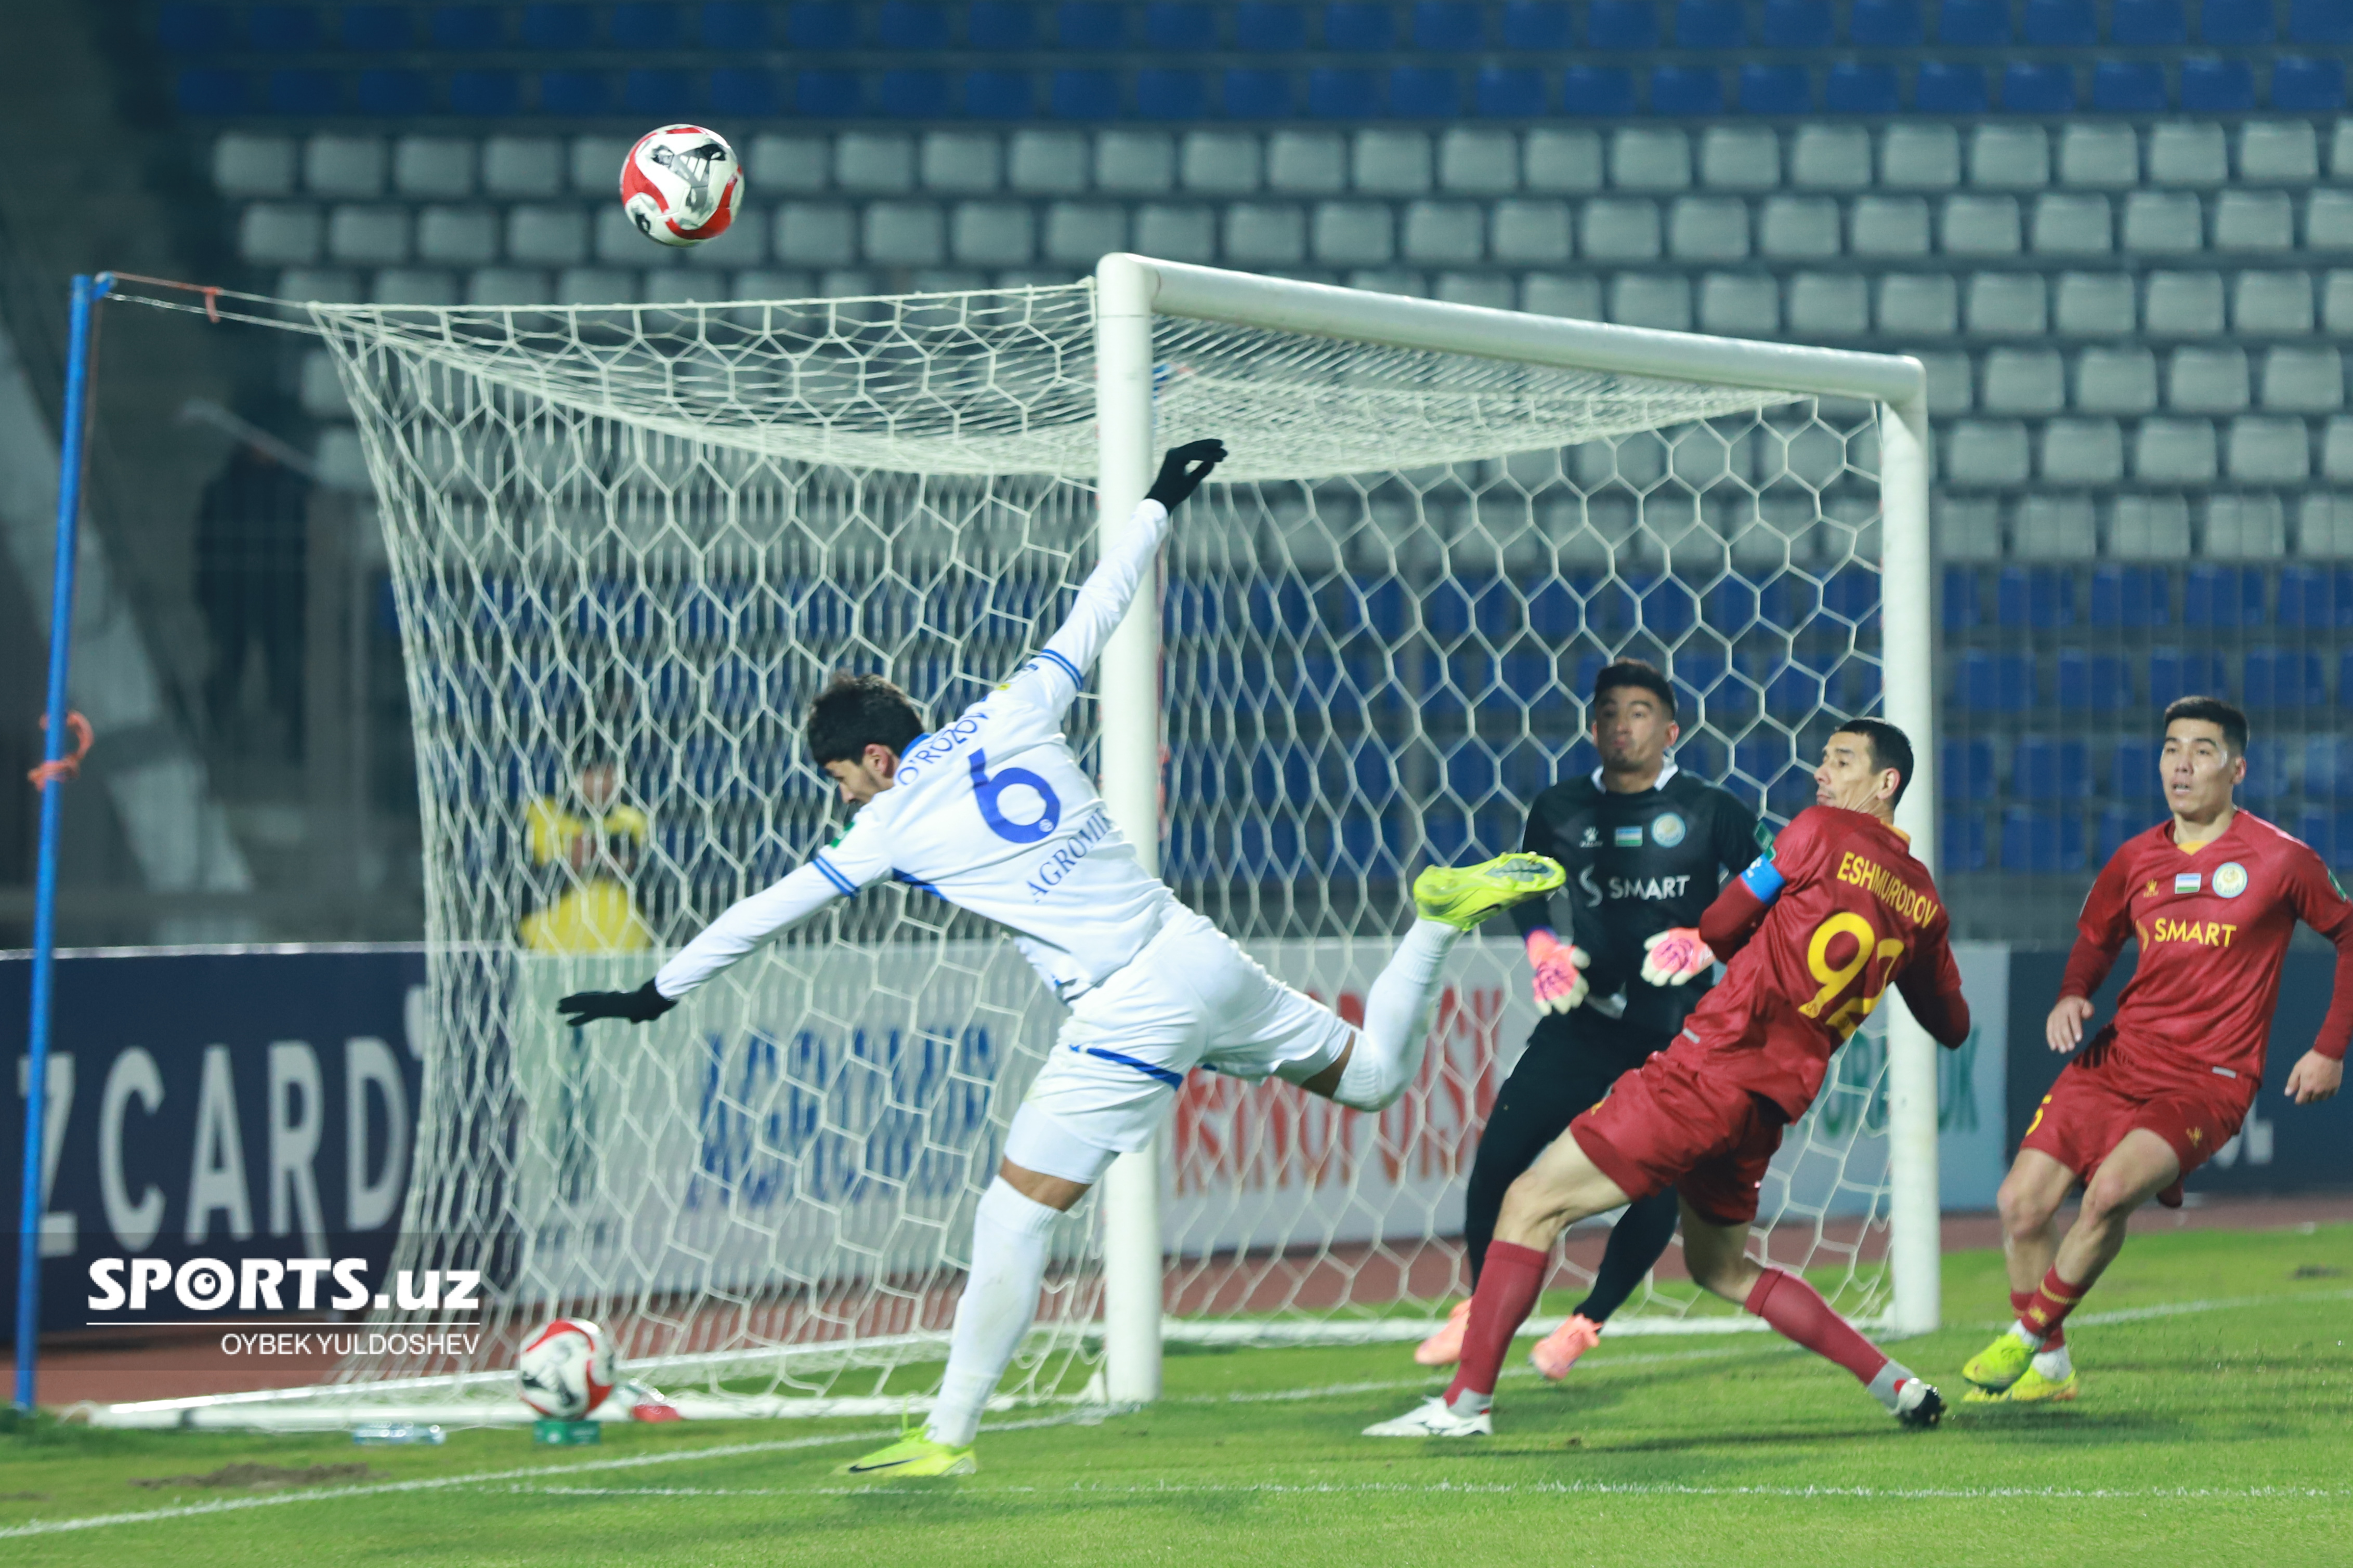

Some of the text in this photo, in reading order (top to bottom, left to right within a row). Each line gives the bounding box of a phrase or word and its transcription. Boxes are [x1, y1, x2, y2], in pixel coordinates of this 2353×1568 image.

[969, 747, 1061, 844] 6
[1609, 875, 1691, 900] SMART
[1837, 851, 1939, 929] ESHMURODOV
[2154, 917, 2237, 947] SMART
[1798, 912, 1904, 1040] 92
